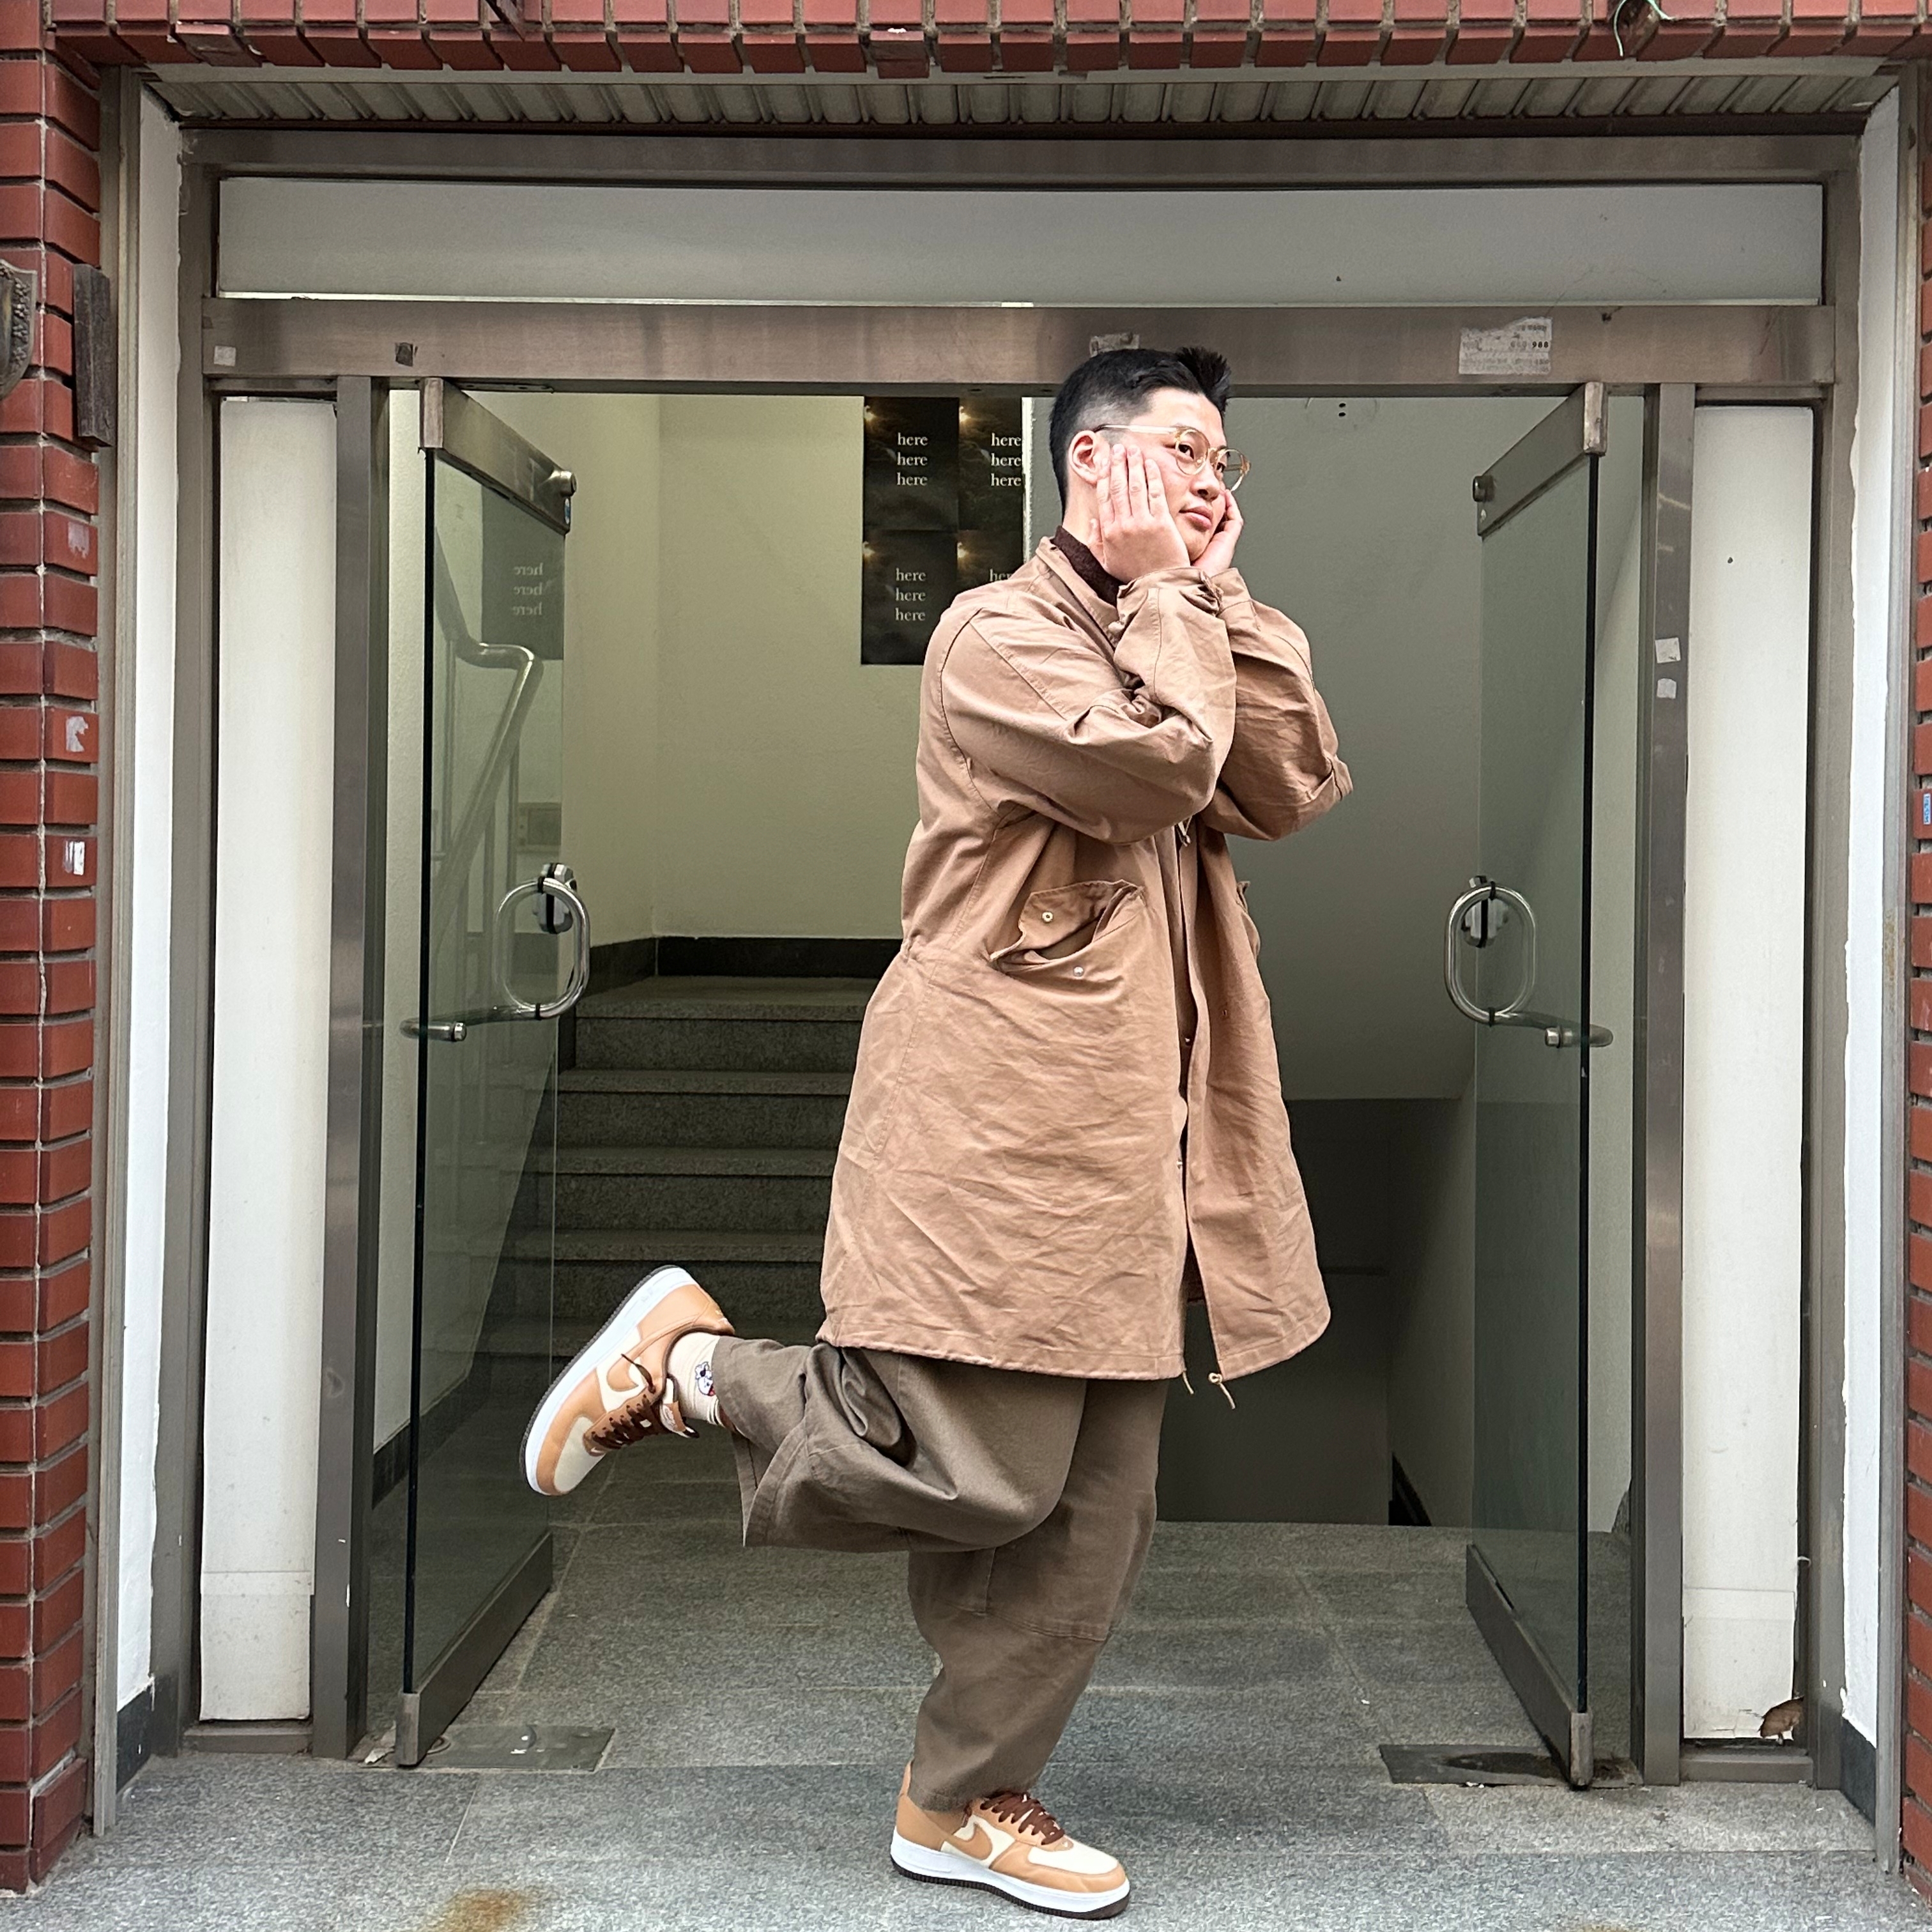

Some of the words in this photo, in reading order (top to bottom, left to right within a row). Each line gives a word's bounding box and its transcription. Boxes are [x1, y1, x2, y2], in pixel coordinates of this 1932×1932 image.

[897, 433, 928, 447] here
[991, 433, 1022, 447] here
[896, 452, 928, 466] here
[990, 452, 1022, 467] here
[896, 472, 928, 486] here
[990, 473, 1022, 487] here
[896, 568, 926, 581] here
[990, 569, 1013, 582] her
[895, 588, 926, 602] here
[895, 608, 926, 622] here
